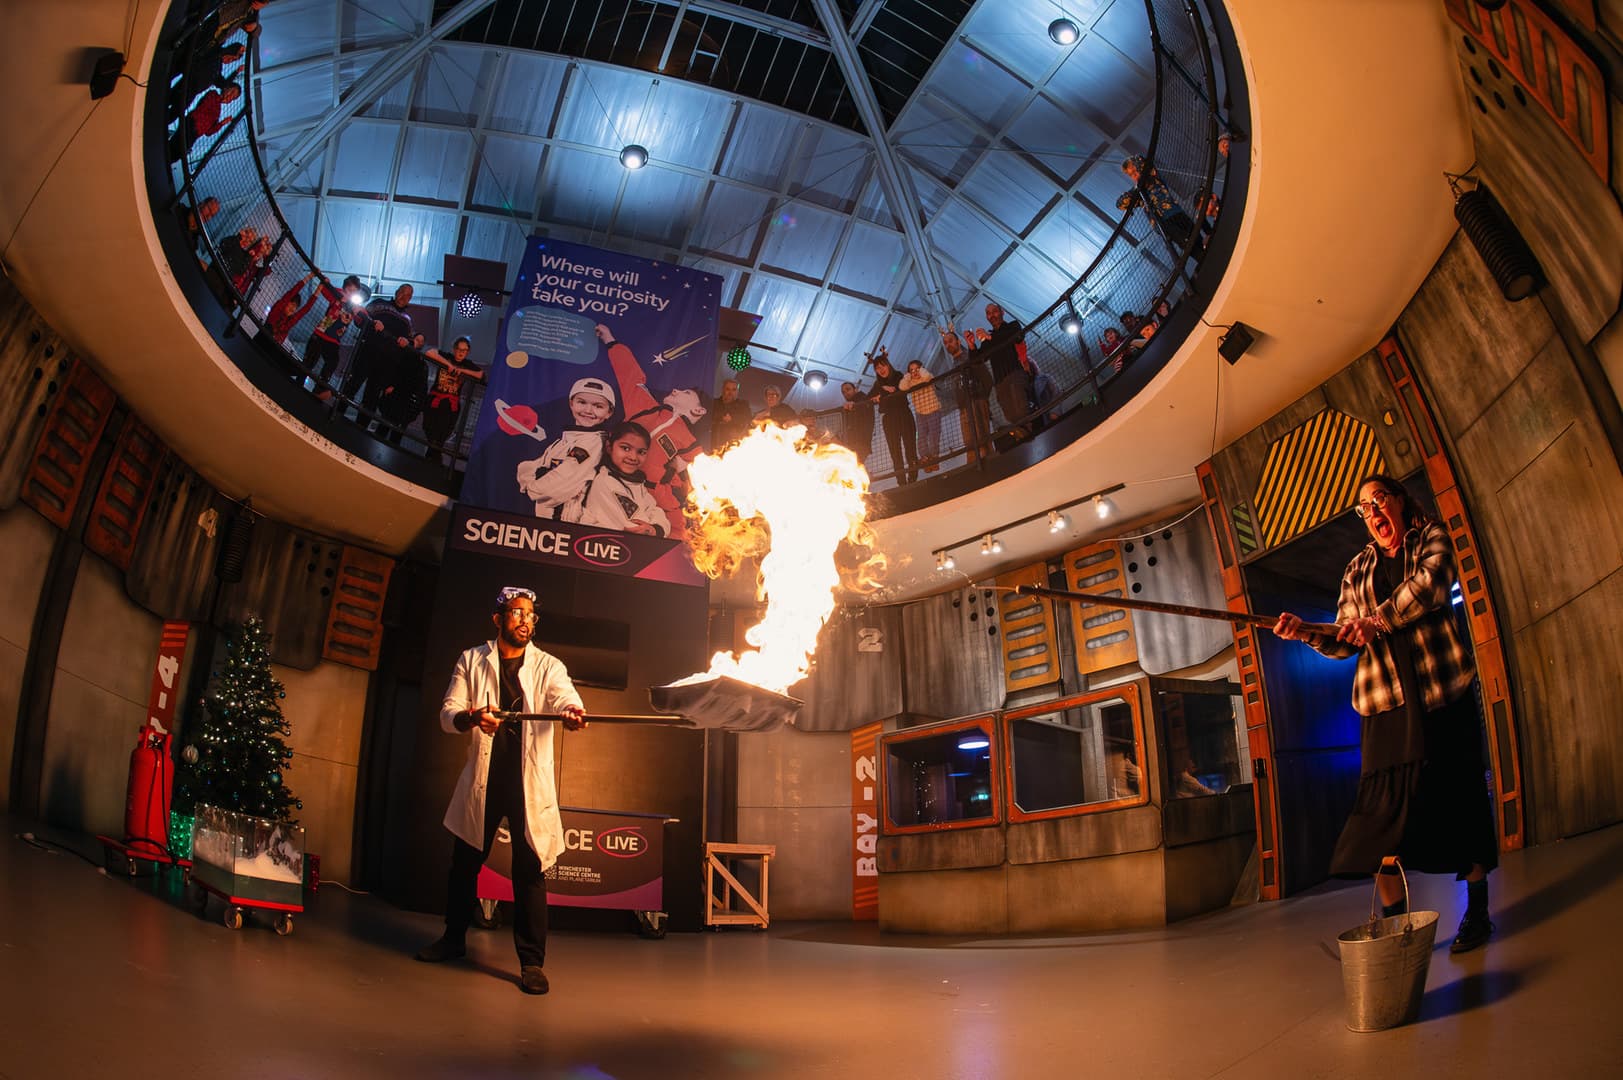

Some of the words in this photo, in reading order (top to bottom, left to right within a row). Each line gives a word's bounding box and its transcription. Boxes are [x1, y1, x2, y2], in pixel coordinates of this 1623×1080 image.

[541, 254, 605, 278] Where
[609, 271, 640, 286] will
[531, 286, 575, 306] take
[578, 298, 629, 316] you?
[534, 272, 582, 290] your
[585, 285, 670, 311] curiosity
[464, 518, 571, 556] SCIENCE
[583, 541, 621, 561] LIVE
[858, 627, 883, 652] 2
[605, 835, 639, 851] LIVE
